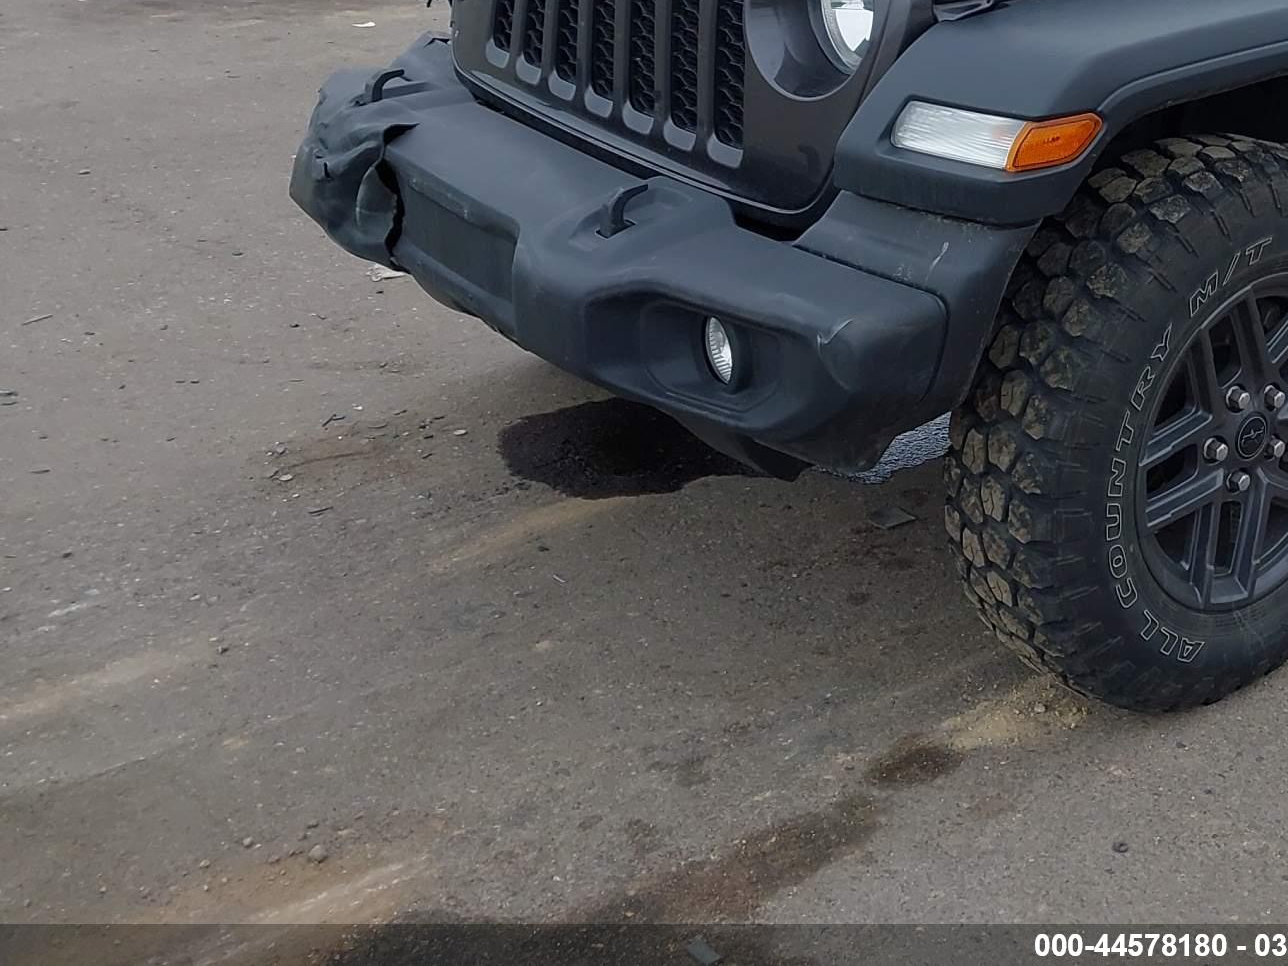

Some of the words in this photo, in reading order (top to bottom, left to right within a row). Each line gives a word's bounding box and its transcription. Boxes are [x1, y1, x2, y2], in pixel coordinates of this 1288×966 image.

[1188, 236, 1273, 318] M/T
[1105, 322, 1173, 609] COUNTRY
[1138, 608, 1205, 664] ALL
